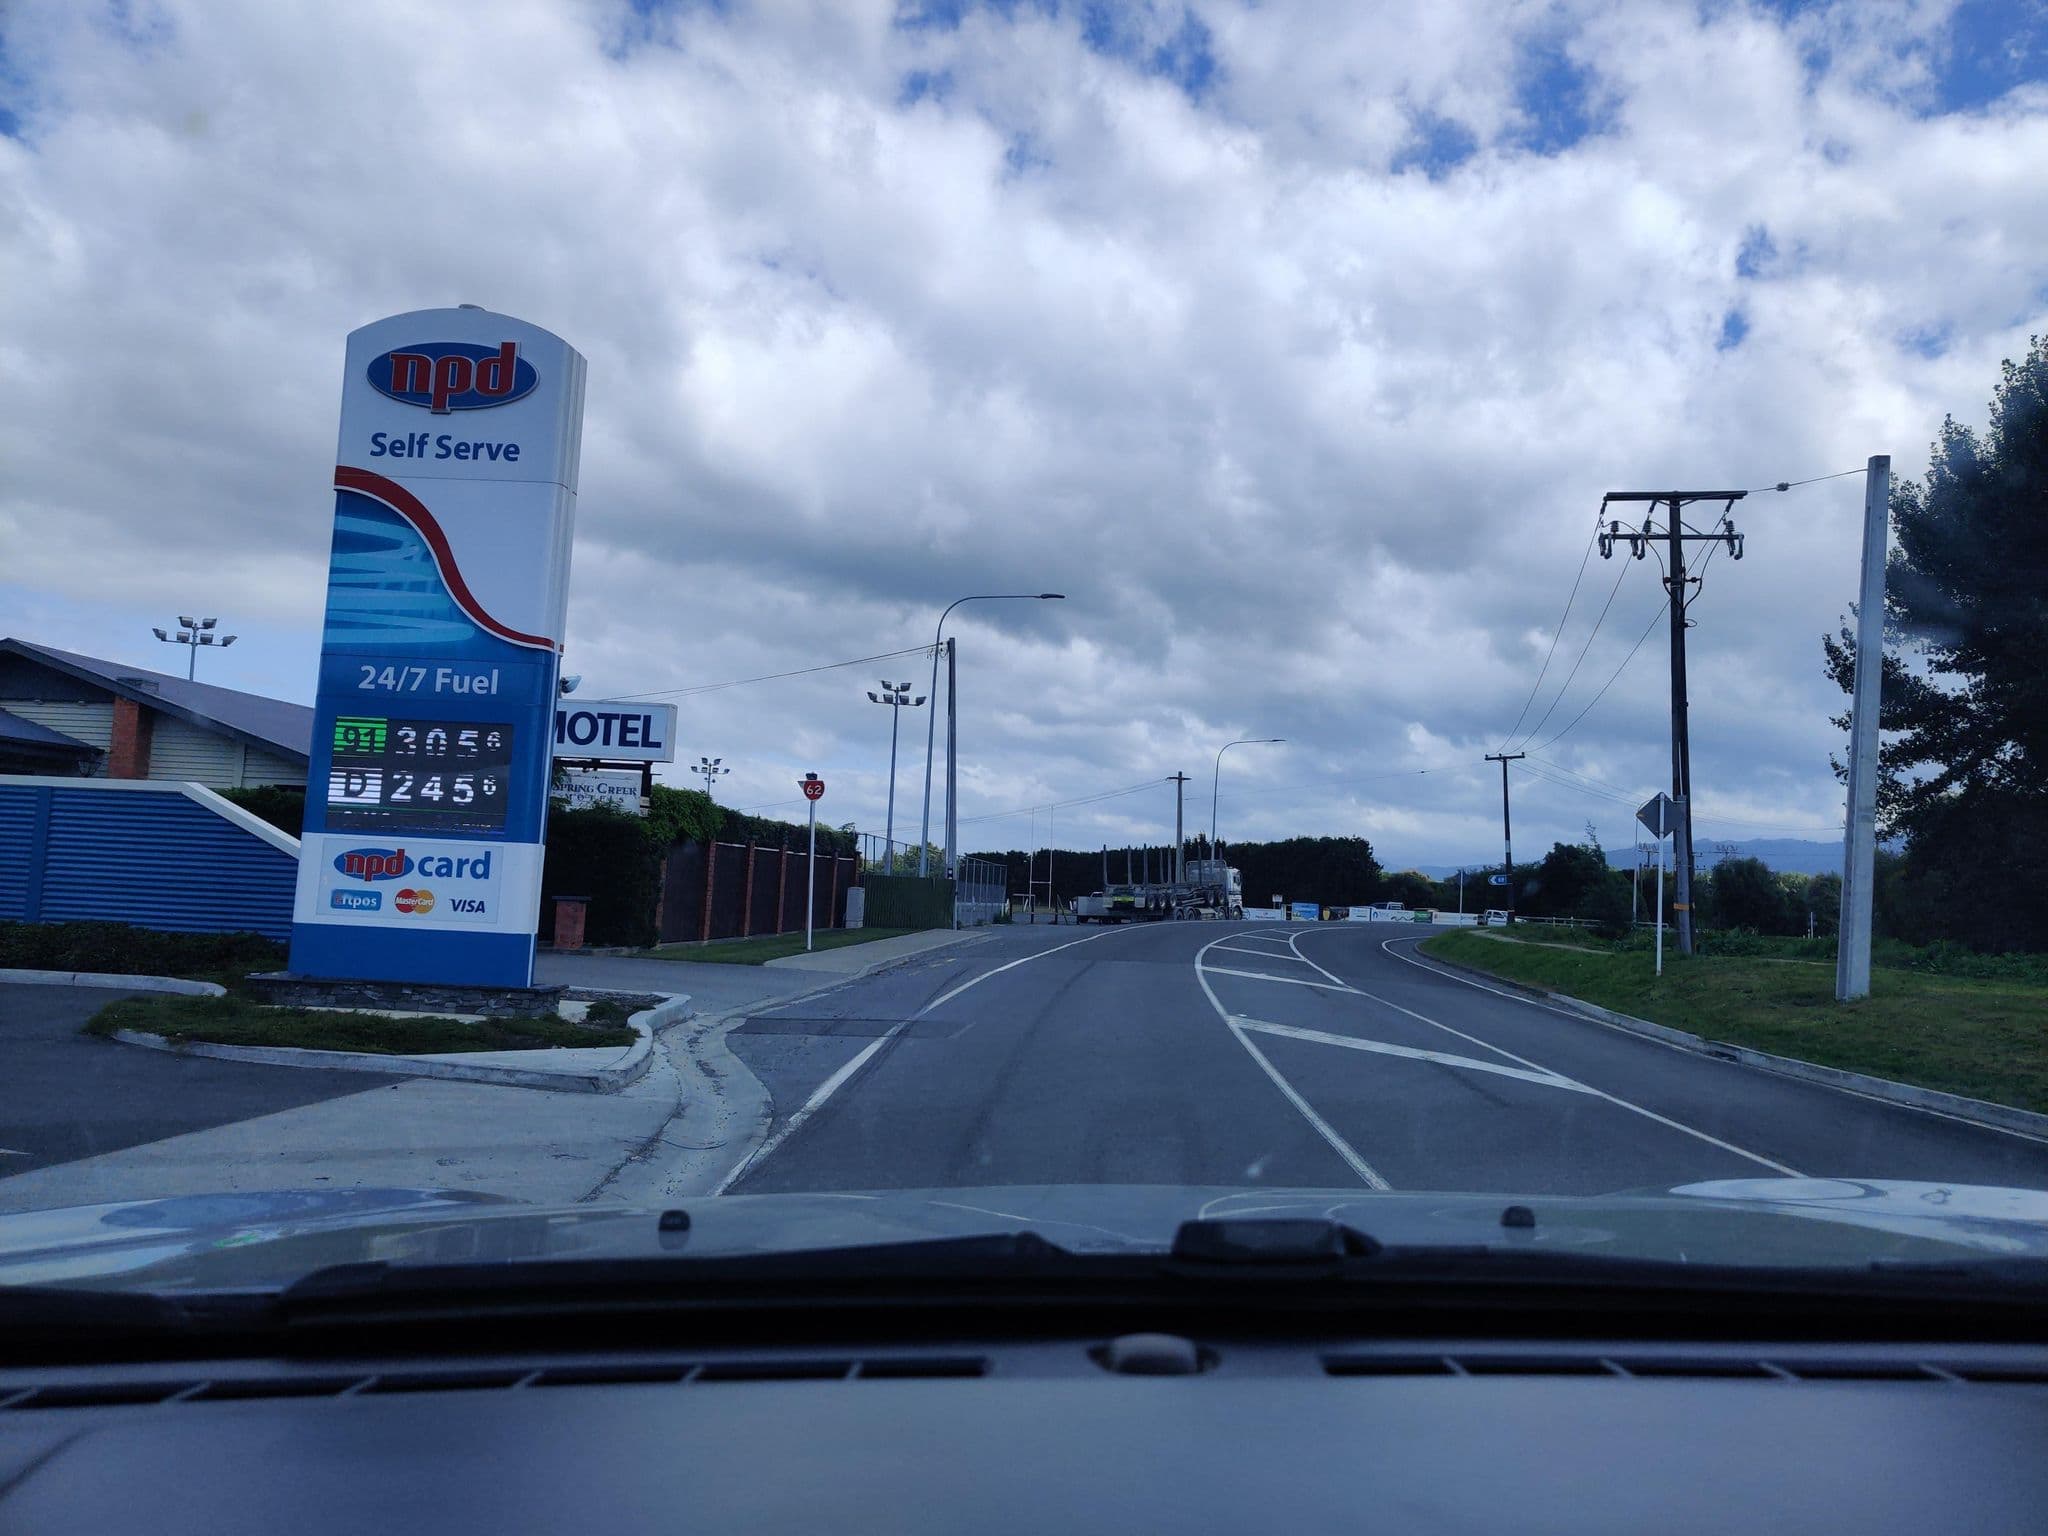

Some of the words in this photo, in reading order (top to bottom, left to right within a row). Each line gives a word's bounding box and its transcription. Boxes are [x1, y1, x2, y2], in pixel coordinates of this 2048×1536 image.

[390, 341, 516, 410] npd
[369, 432, 430, 459] Self
[434, 434, 521, 462] Serve
[358, 665, 427, 692] 24/7
[434, 668, 499, 695] Fuel
[343, 727, 375, 751] 91
[807, 785, 821, 795] 62
[343, 848, 406, 882] npd
[417, 851, 492, 880] card
[448, 898, 486, 914] VISA
